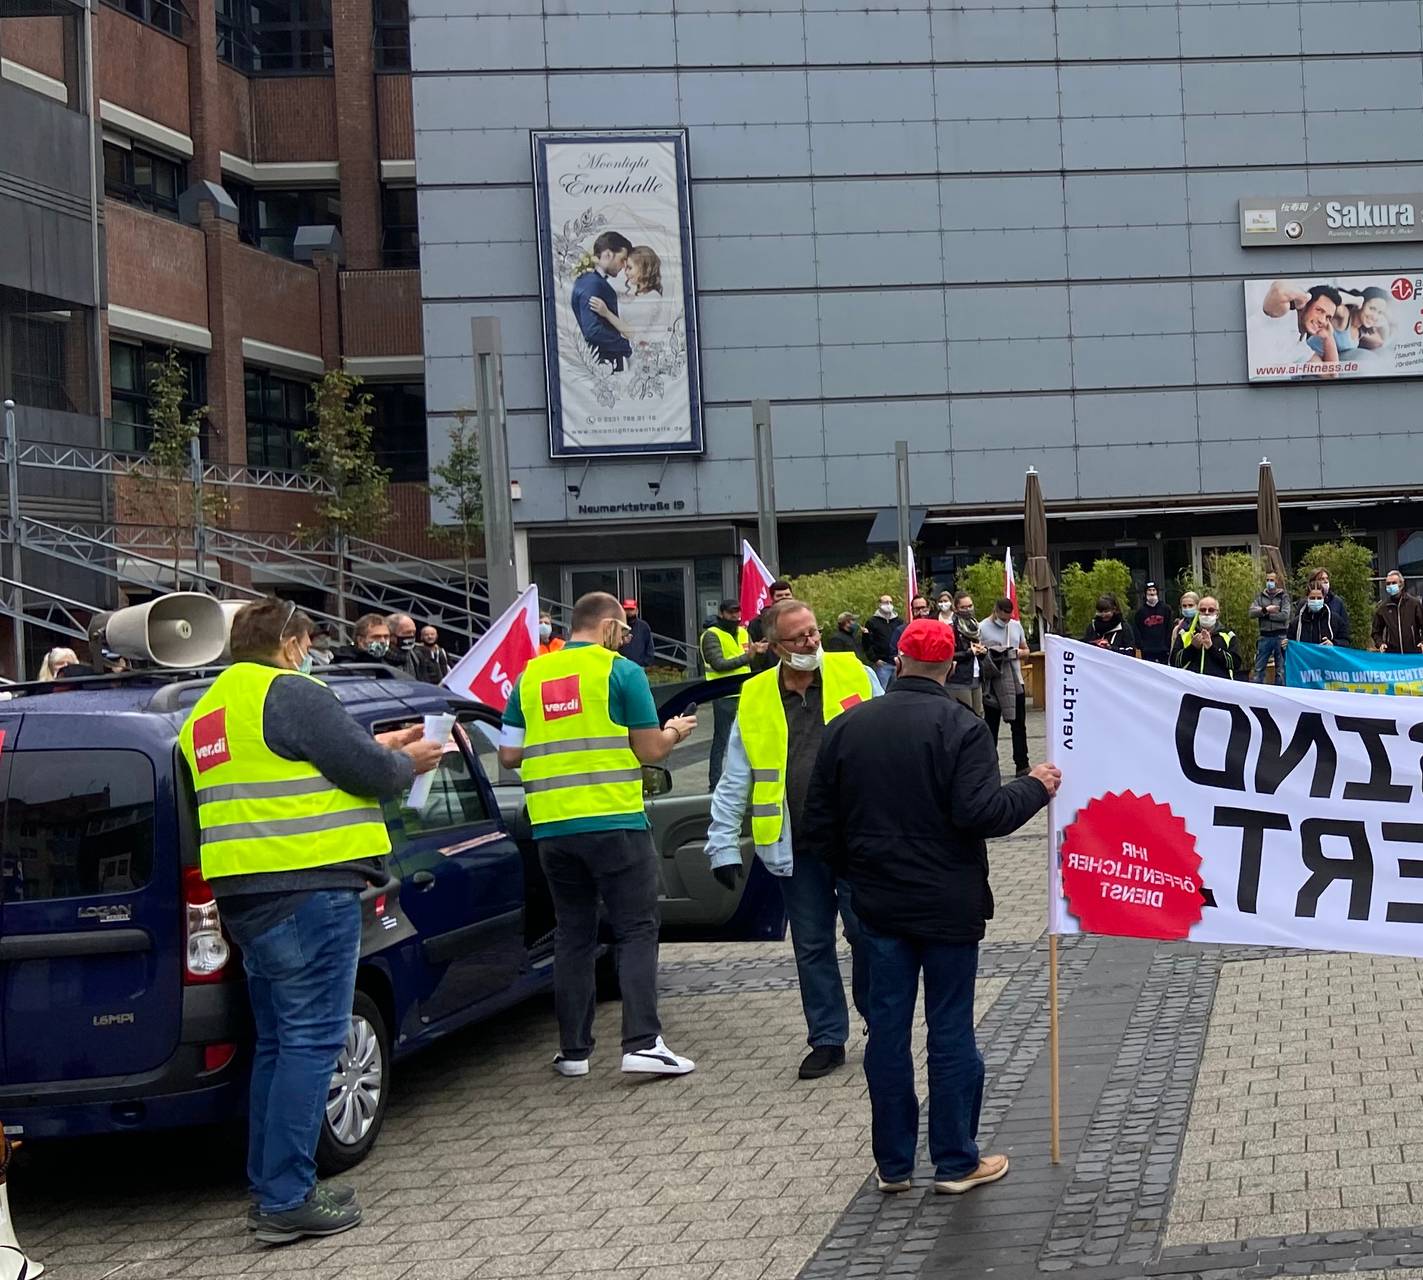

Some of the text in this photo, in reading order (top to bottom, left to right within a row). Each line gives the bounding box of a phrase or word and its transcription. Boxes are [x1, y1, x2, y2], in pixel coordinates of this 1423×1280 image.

[577, 151, 650, 174] Moonlight
[559, 173, 663, 197] Eventhalle
[1326, 200, 1415, 229] Sakura
[1256, 362, 1358, 375] www.ai-fitness.de
[578, 500, 685, 514] Neumarktstraße 19
[1300, 669, 1323, 683] WIR
[1324, 670, 1349, 682] SIND
[544, 699, 578, 712] ver.di
[196, 737, 226, 759] ver.di
[78, 904, 131, 918] LOGAN
